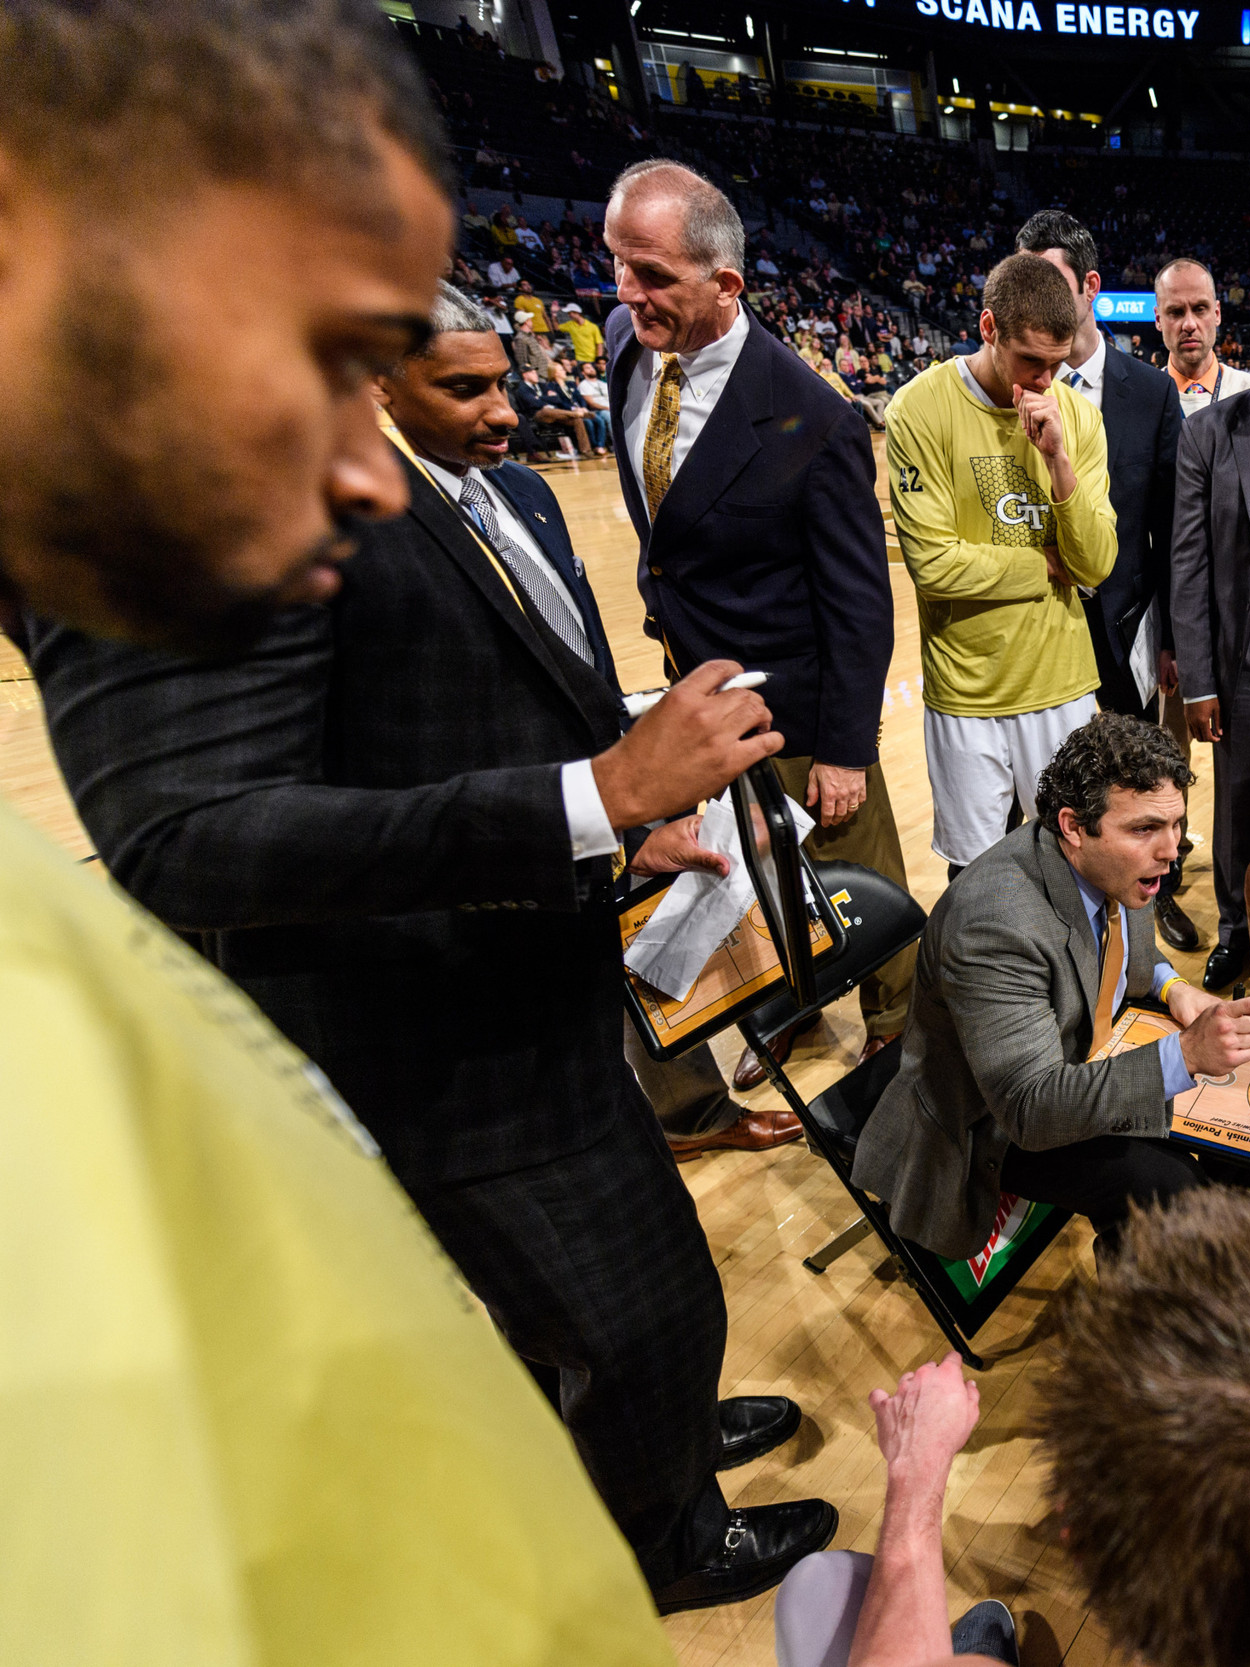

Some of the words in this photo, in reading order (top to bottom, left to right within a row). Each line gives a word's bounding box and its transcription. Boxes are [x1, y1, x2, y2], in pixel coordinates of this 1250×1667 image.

[917, 0, 1042, 31] SCANA
[1056, 4, 1200, 39] ENERGY
[1115, 301, 1146, 314] AT&T
[899, 466, 923, 492] 42
[996, 492, 1050, 530] GT
[1183, 1119, 1221, 1137] Pavilion
